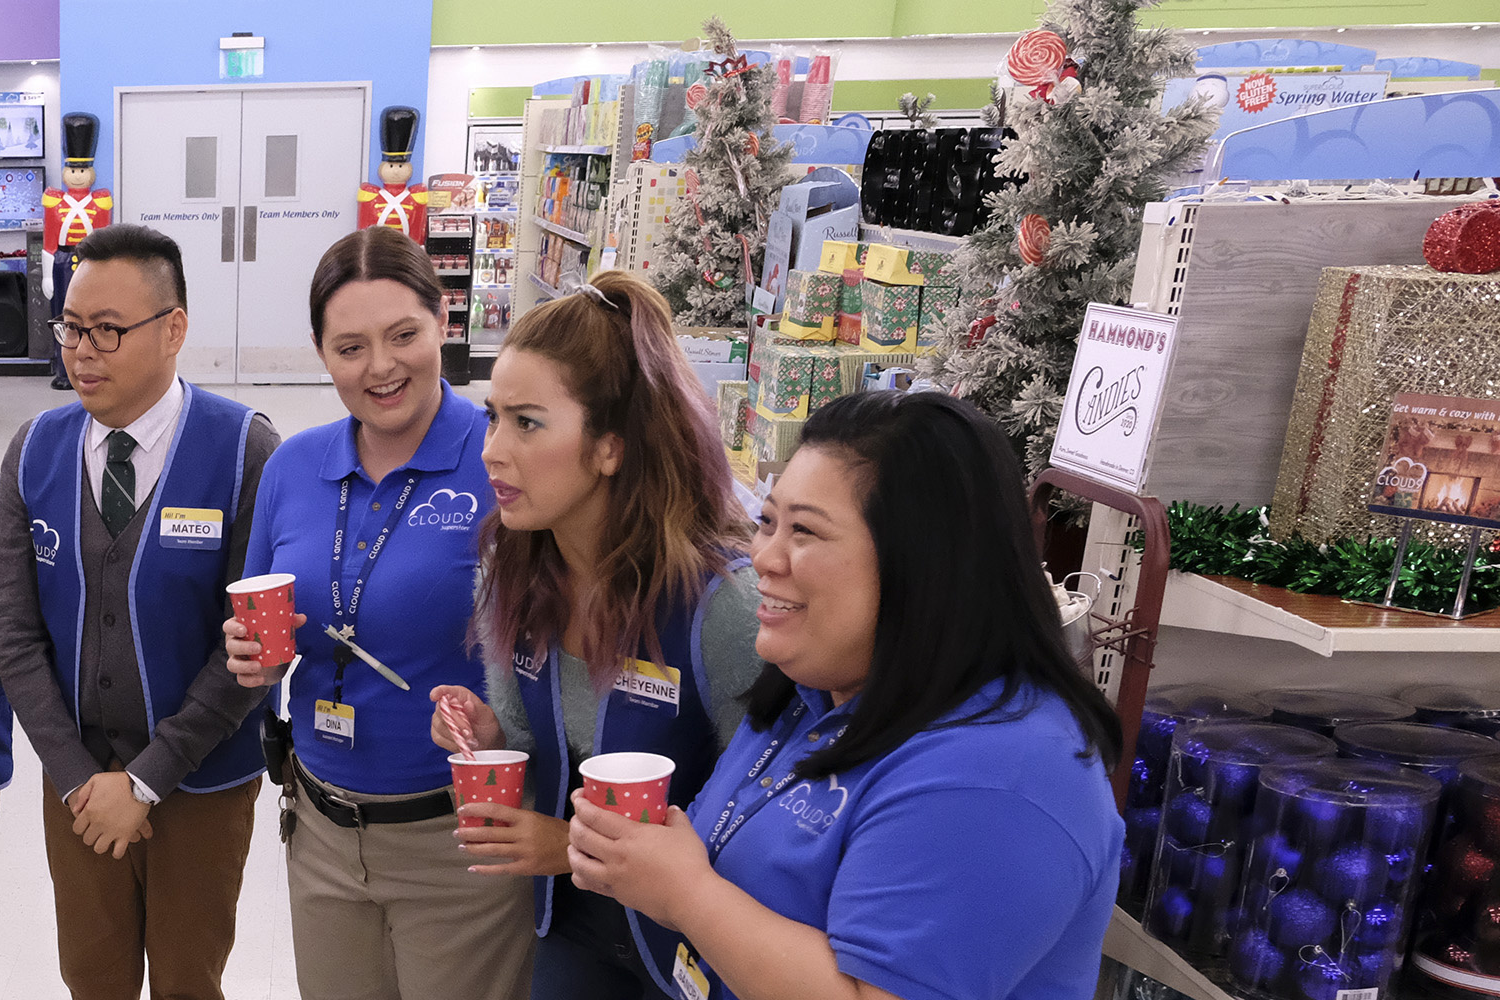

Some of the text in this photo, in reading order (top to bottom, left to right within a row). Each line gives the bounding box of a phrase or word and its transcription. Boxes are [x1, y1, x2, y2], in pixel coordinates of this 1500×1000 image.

[1239, 84, 1274, 102] GLUTEN
[1245, 78, 1266, 91] NOW
[1244, 93, 1270, 107] FREE!
[1276, 90, 1378, 106] Spring Water
[140, 212, 220, 223] Team Members Only
[259, 209, 340, 220] Team Members Only
[822, 225, 859, 240] Russell
[1087, 320, 1167, 355] HAMMOND'S
[1075, 365, 1145, 437] CANDIES
[1393, 403, 1496, 421] Get warm & cozy with
[1120, 417, 1133, 429] 1920
[1376, 474, 1424, 489] CLOUD9
[340, 480, 349, 505] CLOUD
[395, 486, 412, 510] CLOUD
[171, 523, 211, 535] MATEO
[408, 512, 474, 527] CLOUD9
[333, 530, 343, 554] CLOUD
[368, 535, 386, 560] CLOUD
[332, 580, 341, 609] CLOUD
[349, 586, 361, 614] CLOUD
[615, 675, 676, 699] CHEYENNE
[326, 719, 341, 731] DINA
[748, 748, 773, 778] CLOUD
[779, 793, 834, 829] CLOUD9
[709, 810, 730, 843] CLOUD
[720, 814, 744, 843] CLOUD
